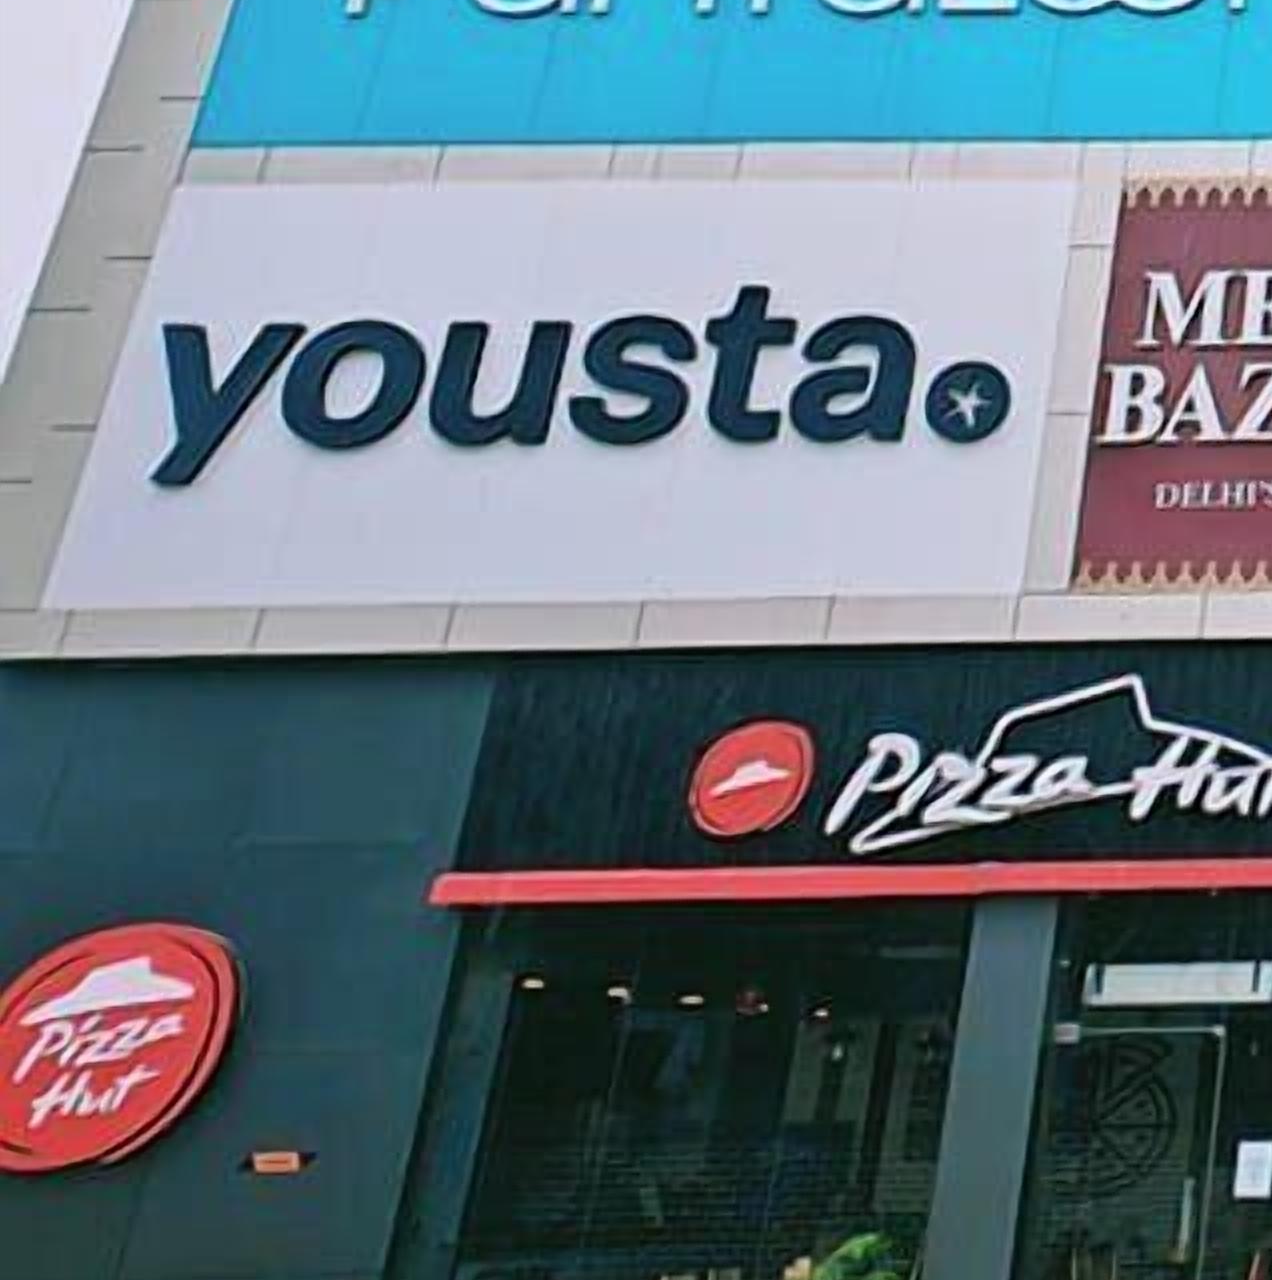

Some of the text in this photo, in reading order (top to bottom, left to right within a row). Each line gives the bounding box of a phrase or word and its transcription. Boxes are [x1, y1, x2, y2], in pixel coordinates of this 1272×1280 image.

[825, 732, 1098, 856] Pizza
[12, 1012, 184, 1085] Pizza
[27, 1063, 160, 1129] Hut
